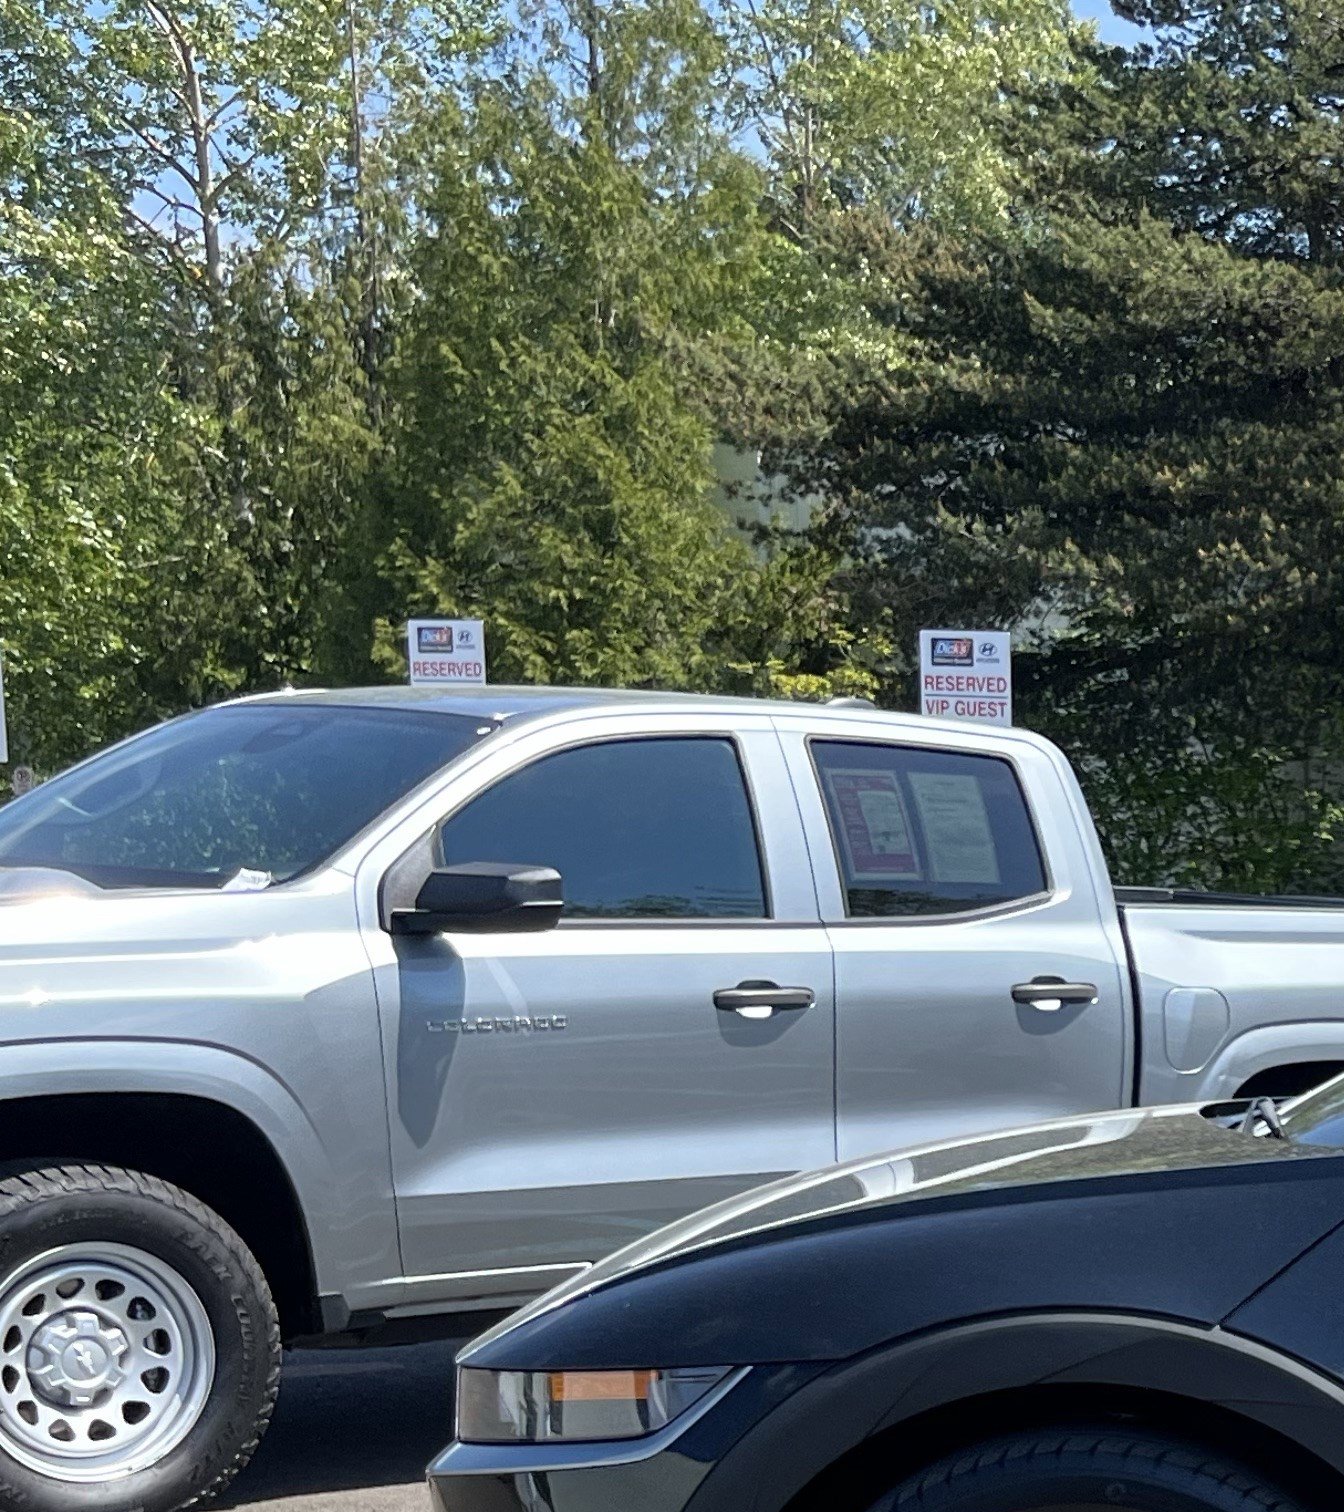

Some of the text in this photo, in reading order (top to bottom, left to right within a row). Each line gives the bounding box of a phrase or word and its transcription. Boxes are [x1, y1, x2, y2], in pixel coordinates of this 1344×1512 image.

[413, 661, 482, 677] RESERVED
[924, 675, 1007, 693] RESERVED
[925, 699, 1007, 718] VIP GUEST
[426, 1014, 568, 1032] COLORADO
